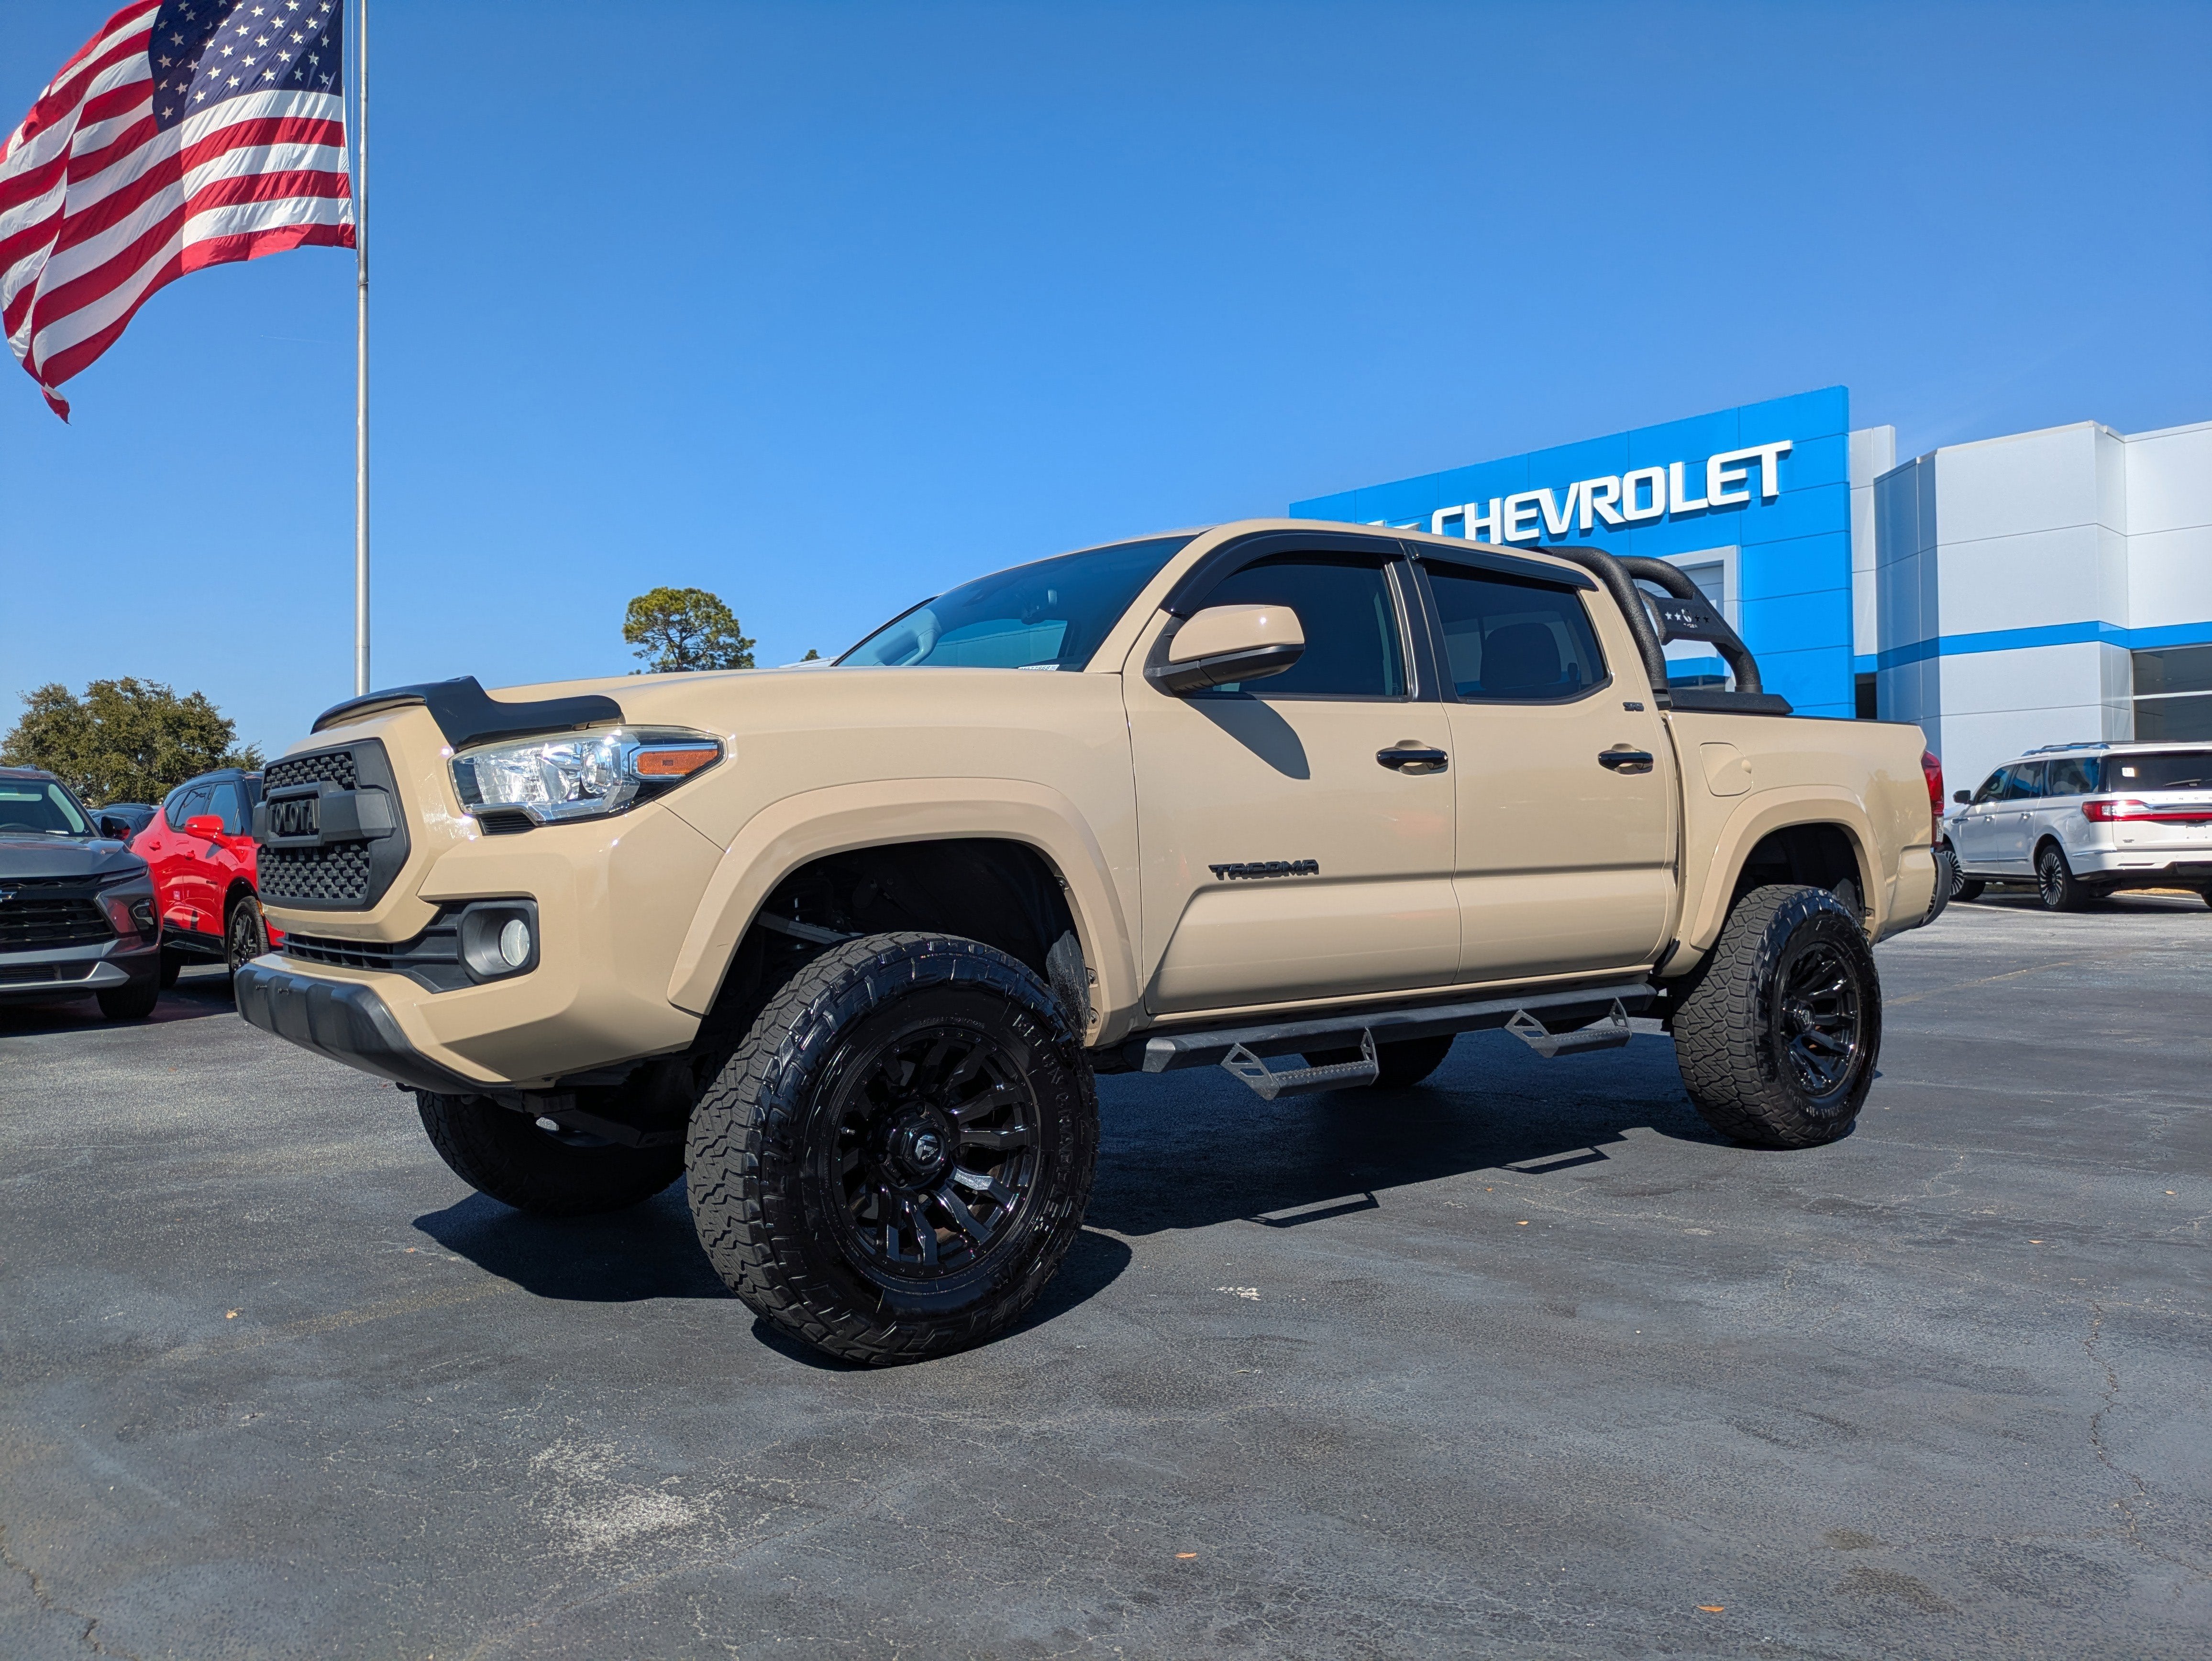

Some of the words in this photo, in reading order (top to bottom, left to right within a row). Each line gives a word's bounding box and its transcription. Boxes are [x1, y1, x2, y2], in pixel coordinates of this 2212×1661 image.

[1431, 440, 1793, 544] CHEVROLET
[267, 798, 319, 833] TOYOTA
[1208, 859, 1319, 880] TACOMA
